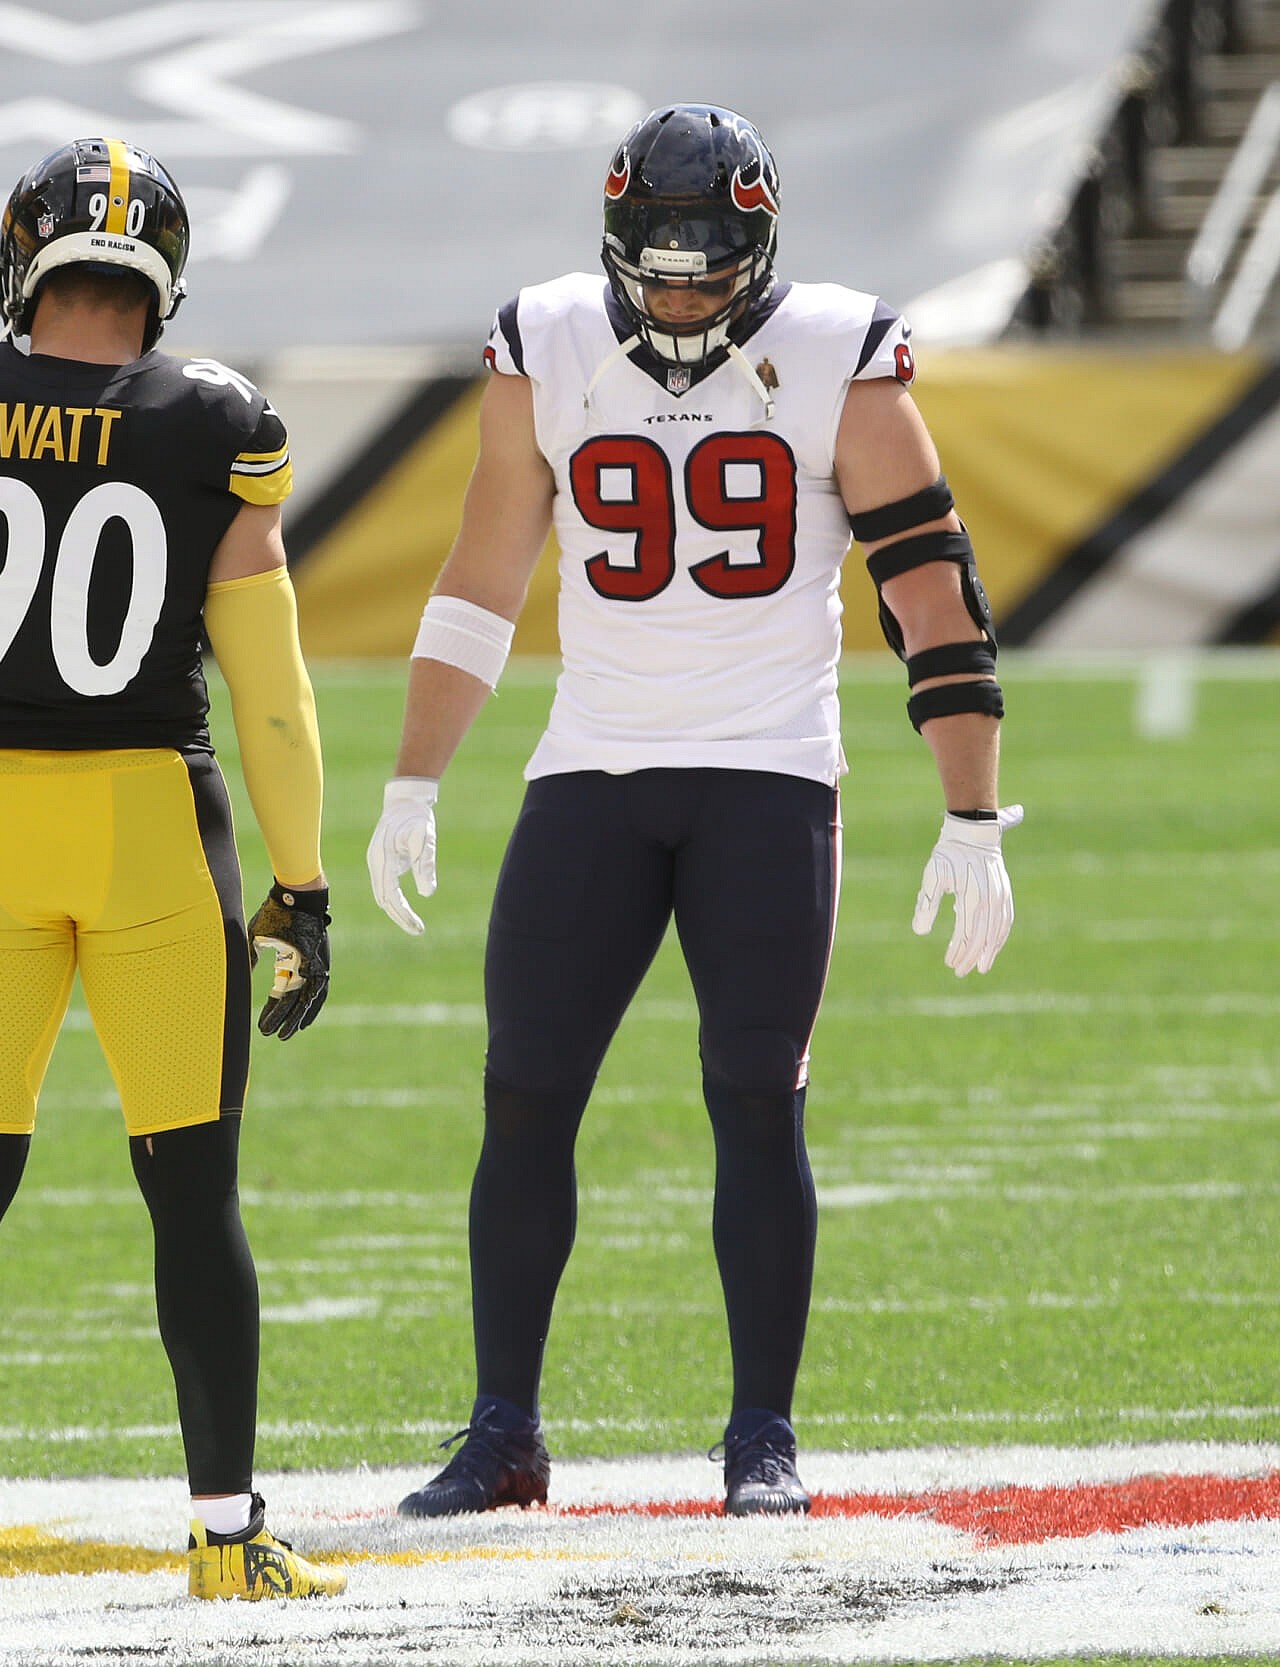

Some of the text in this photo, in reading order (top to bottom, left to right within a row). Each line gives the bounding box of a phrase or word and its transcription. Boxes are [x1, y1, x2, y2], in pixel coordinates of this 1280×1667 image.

[89, 192, 146, 237] 90
[91, 239, 136, 252] END RACISM
[643, 413, 713, 425] TEXANS
[570, 430, 798, 601] 99
